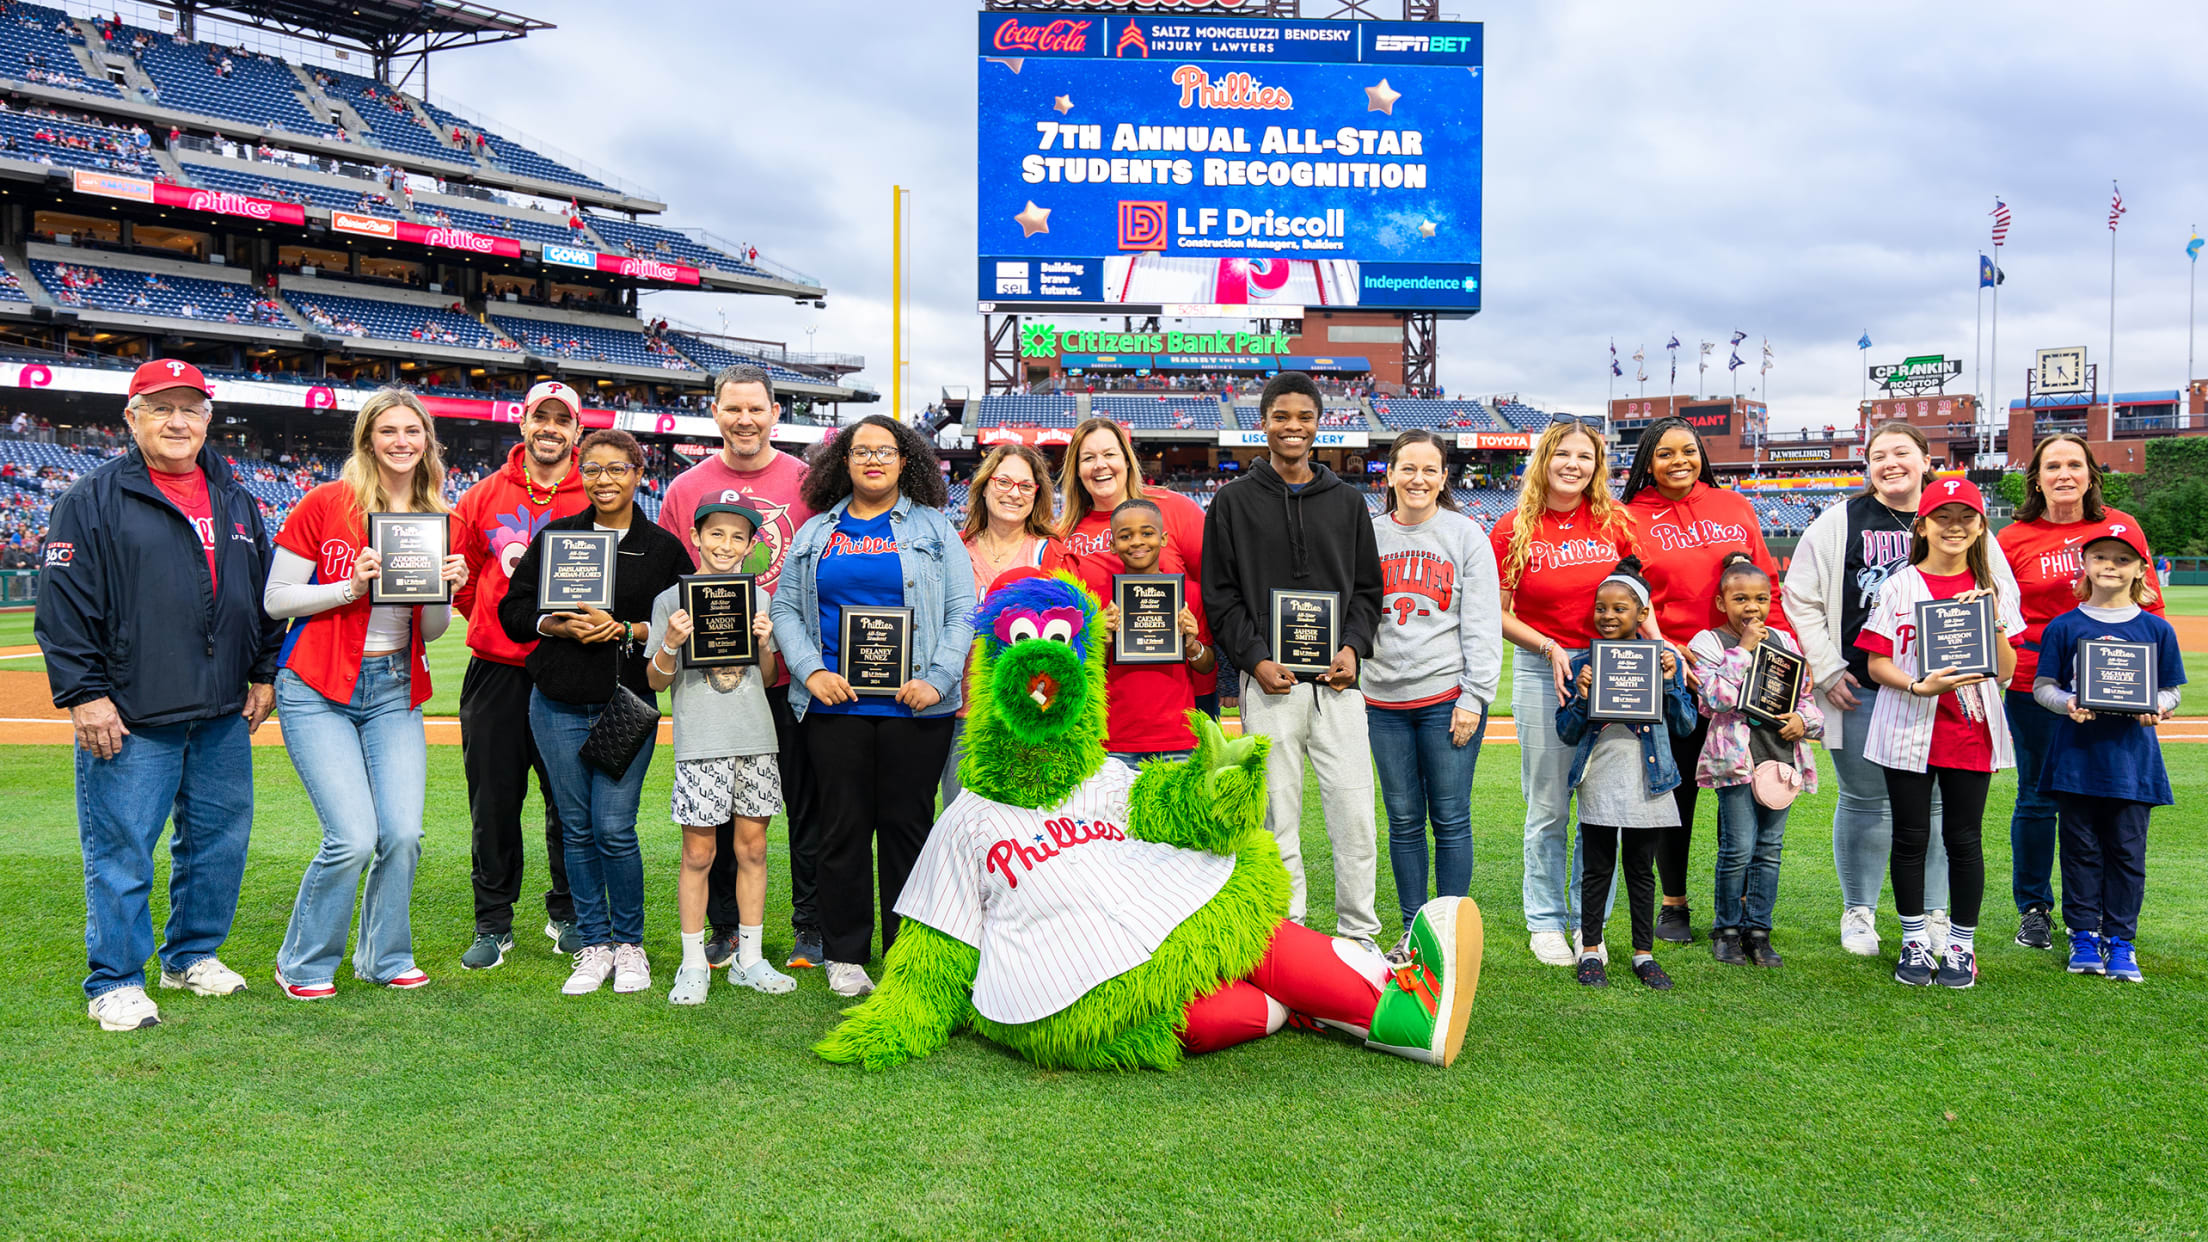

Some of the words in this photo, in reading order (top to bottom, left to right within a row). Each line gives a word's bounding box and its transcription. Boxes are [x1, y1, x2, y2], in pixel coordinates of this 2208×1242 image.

[994, 18, 1092, 51] Coca-Cola
[1151, 26, 1190, 38] SALTZ
[1196, 26, 1279, 40] MONGELUZZI
[1284, 28, 1351, 41] BENDESKY
[1151, 41, 1202, 51] INJURY
[1212, 42, 1275, 53] LAWYERS
[1172, 65, 1293, 110] Phillies
[1037, 121, 1101, 150] 7TH
[1111, 123, 1251, 152] ANNUAL
[1260, 126, 1423, 156] ALL-STAR
[1022, 154, 1193, 184] STUDENTS
[1203, 158, 1427, 188] RECOGNITION
[1177, 208, 1218, 235] LF
[1227, 208, 1344, 237] Driscoll
[1177, 238, 1244, 249] Construction
[1246, 239, 1299, 251] Managers,
[1302, 239, 1344, 250] Builders
[550, 247, 590, 265] GOYA
[1040, 262, 1084, 275] Building
[1040, 273, 1070, 284] brave
[1364, 275, 1459, 291] Independence
[1061, 330, 1161, 353] Citizens
[1167, 331, 1231, 354] Bank
[1234, 331, 1290, 354] Park
[1875, 366, 1898, 378] CP
[1898, 361, 1955, 376] RANKIN
[1890, 379, 1939, 389] ROOFTOP
[1051, 428, 1073, 444] BEA
[1242, 434, 1268, 443] LISC
[1313, 435, 1344, 444] KERY
[1481, 436, 1528, 447] TOYOTA
[1651, 520, 1747, 550] Phillies
[562, 539, 597, 550] Phillies
[702, 586, 737, 599] Phillies
[1133, 585, 1167, 597] Phillies
[1290, 600, 1322, 612] Phillies
[1936, 608, 1971, 618] Phillies
[706, 617, 736, 625] LANDON
[708, 623, 734, 631] MARSH
[860, 617, 894, 630] Phillies
[1937, 632, 1972, 641] MADISON
[1610, 648, 1644, 659] Phillies
[2100, 647, 2136, 658] Phillies
[986, 817, 1126, 889] Phillies
